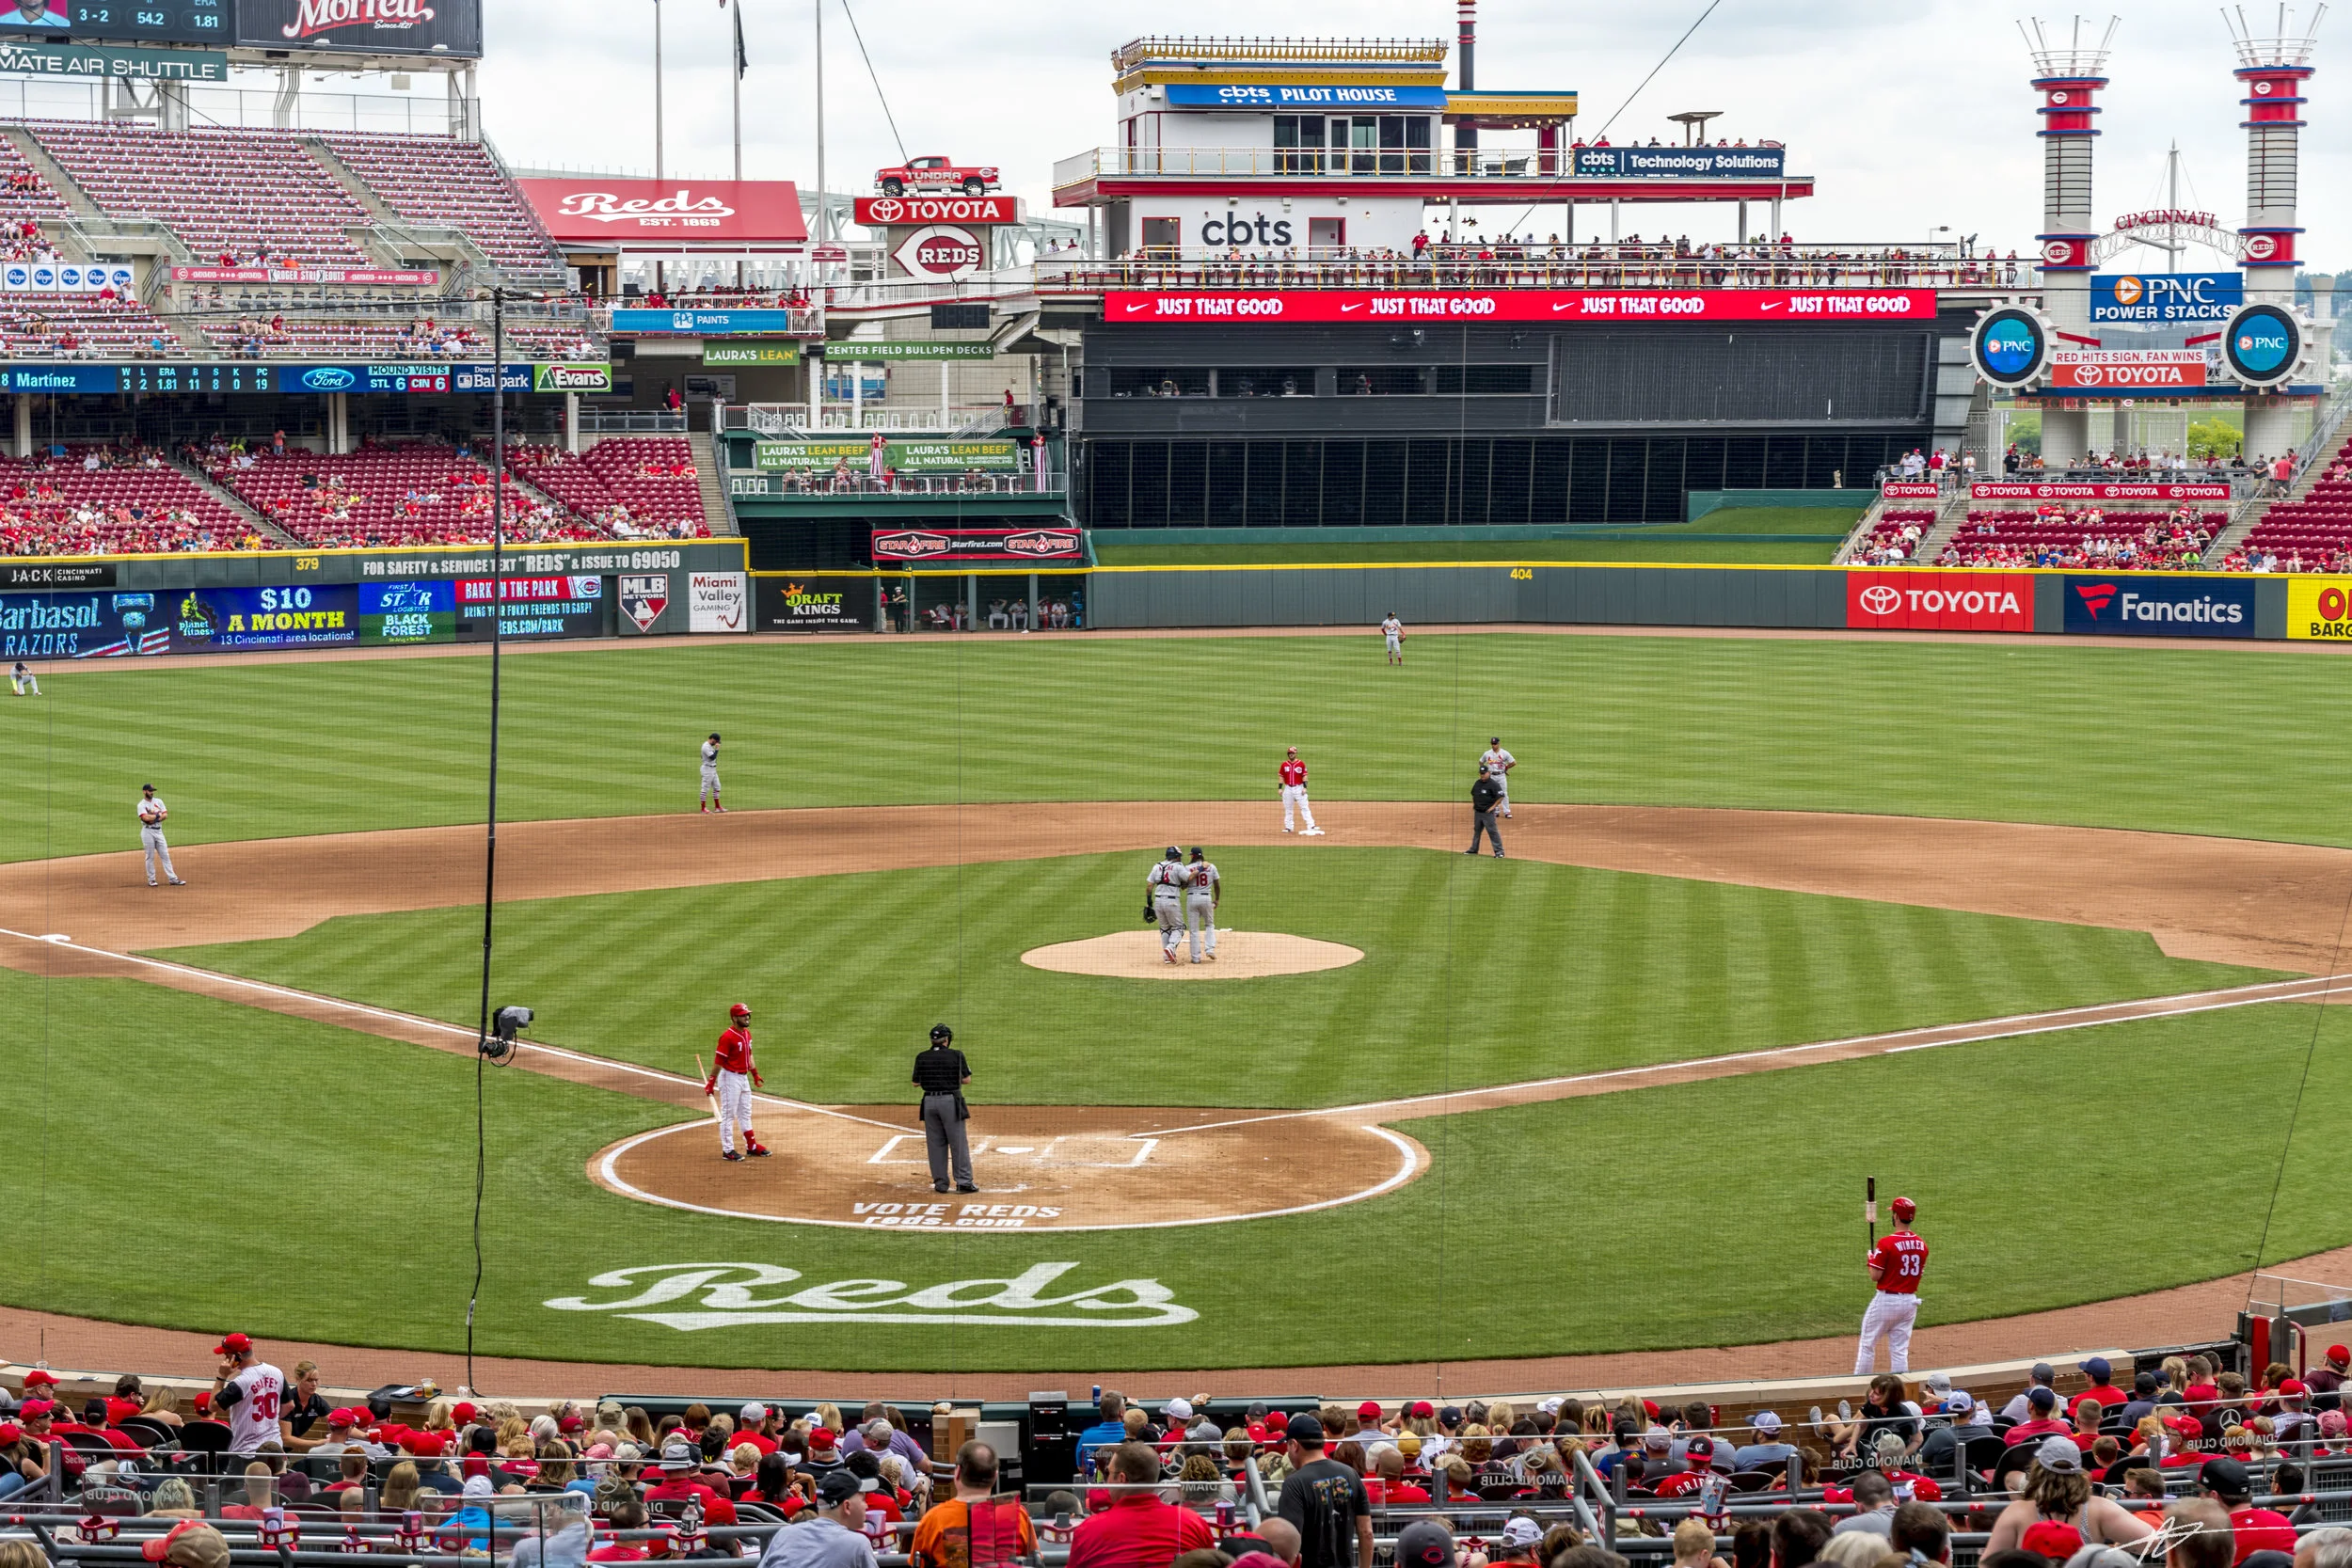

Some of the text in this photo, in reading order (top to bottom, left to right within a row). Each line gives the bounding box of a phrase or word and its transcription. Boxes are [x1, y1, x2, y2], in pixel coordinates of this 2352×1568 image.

[138, 12, 164, 25] 54.2
[194, 15, 218, 27] 1.81
[67, 57, 104, 74] AIR
[112, 60, 215, 78] SHUTTLE
[1218, 86, 1397, 102] cbts PILOT HOUSE
[1581, 150, 1779, 170] cbts Technology Solutions
[906, 171, 961, 180] TUNDRA
[558, 190, 735, 220] Reds
[907, 200, 1000, 218] TOYOTA
[640, 218, 721, 227] EST. 1869
[2116, 209, 2216, 230] CINCINNATI
[1201, 211, 1292, 246] cbts
[920, 247, 980, 263] REDS
[2145, 277, 2216, 303] PNC
[1155, 296, 1283, 315] JUST THAT GOOD
[1788, 294, 1911, 313] JUST THAT GOOD
[674, 312, 729, 327] PPG PAINTS
[2095, 305, 2233, 320] POWER STACKS
[827, 346, 992, 355] CENTER FIELD BULLPEN DECKS
[2003, 341, 2031, 352] PNC
[2255, 338, 2284, 349] PNC
[707, 350, 793, 360] LAURA'S LEAN
[2057, 352, 2202, 363] RED HITS SIGN, FAN WINS
[122, 368, 131, 376] W
[159, 368, 176, 376] ERA
[213, 368, 219, 376] S
[233, 368, 240, 376] K
[257, 368, 268, 376] PC
[372, 366, 446, 374] MOUND VISITS
[2106, 367, 2183, 382] TOYOTA
[17, 372, 76, 388] Martínez
[158, 379, 268, 390] 1.81 11 19
[312, 372, 344, 387] Ford
[370, 377, 446, 389] STL 6 CIN 6
[556, 371, 605, 386] Evans
[906, 446, 949, 454] LAURA'S
[951, 446, 979, 454] LEAN
[1899, 486, 1936, 495] TOYOTA
[1992, 487, 2031, 496] TOYOTA
[880, 540, 1003, 550] STAR FIRE Starfire1.com
[295, 558, 319, 571] 379
[363, 562, 385, 576] FOR
[387, 561, 428, 576] SAFETY
[431, 563, 439, 574] &
[440, 562, 487, 574] SERVICE
[572, 560, 580, 570] &
[581, 556, 612, 570] ISSUE
[614, 555, 629, 568] TO
[631, 551, 680, 570] 69050
[1510, 568, 1533, 580] 404
[465, 580, 558, 599] BARK THE PARK
[622, 578, 665, 594] MLB
[693, 577, 738, 588] Miami
[261, 587, 311, 611] $10
[698, 590, 741, 604] Valley
[786, 594, 843, 608] DRAFT
[1906, 589, 2020, 614] TOYOTA
[464, 606, 486, 618] BRING
[507, 605, 529, 616] FURRY
[531, 602, 560, 615] FRIENDS
[562, 603, 570, 614] TO
[793, 604, 840, 615] KINGS
[2122, 594, 2243, 623] Fanatics
[179, 621, 209, 631] planet
[228, 611, 345, 632] A MONTH
[386, 614, 429, 626] BLACK
[183, 627, 215, 636] fitness
[221, 636, 233, 645] 13
[235, 634, 283, 644] Cincinnati
[309, 630, 355, 641] locations!
[382, 625, 433, 636] FOREST
[5, 633, 78, 656] RAZORS
[1163, 872, 1170, 883] 4
[1195, 873, 1208, 887] 18
[851, 1202, 1063, 1219] VOTE REDS
[863, 1212, 1025, 1227] reds.com
[1894, 1240, 1925, 1252] WINKER
[1899, 1255, 1921, 1276] 33
[542, 1261, 1200, 1331] Reds
[252, 1392, 278, 1422] 30
[65, 1455, 89, 1465] Section
